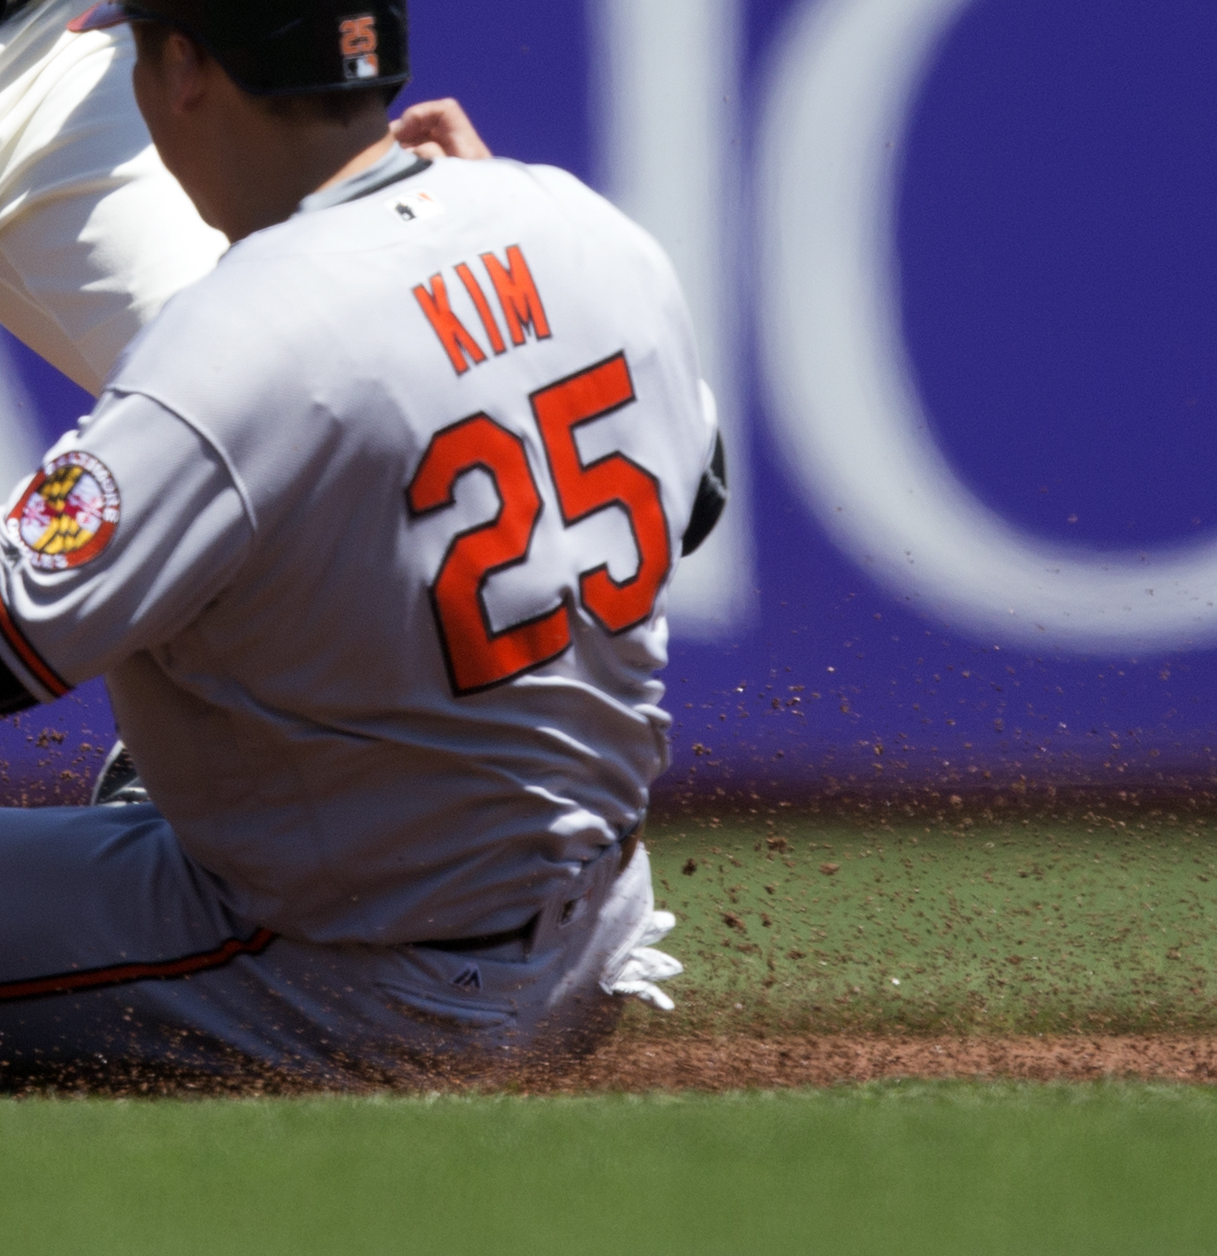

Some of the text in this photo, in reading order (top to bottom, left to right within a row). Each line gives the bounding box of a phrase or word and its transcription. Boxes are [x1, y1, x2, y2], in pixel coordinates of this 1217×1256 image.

[338, 15, 378, 57] 25
[411, 243, 552, 377] KIM
[405, 349, 671, 698] 25
